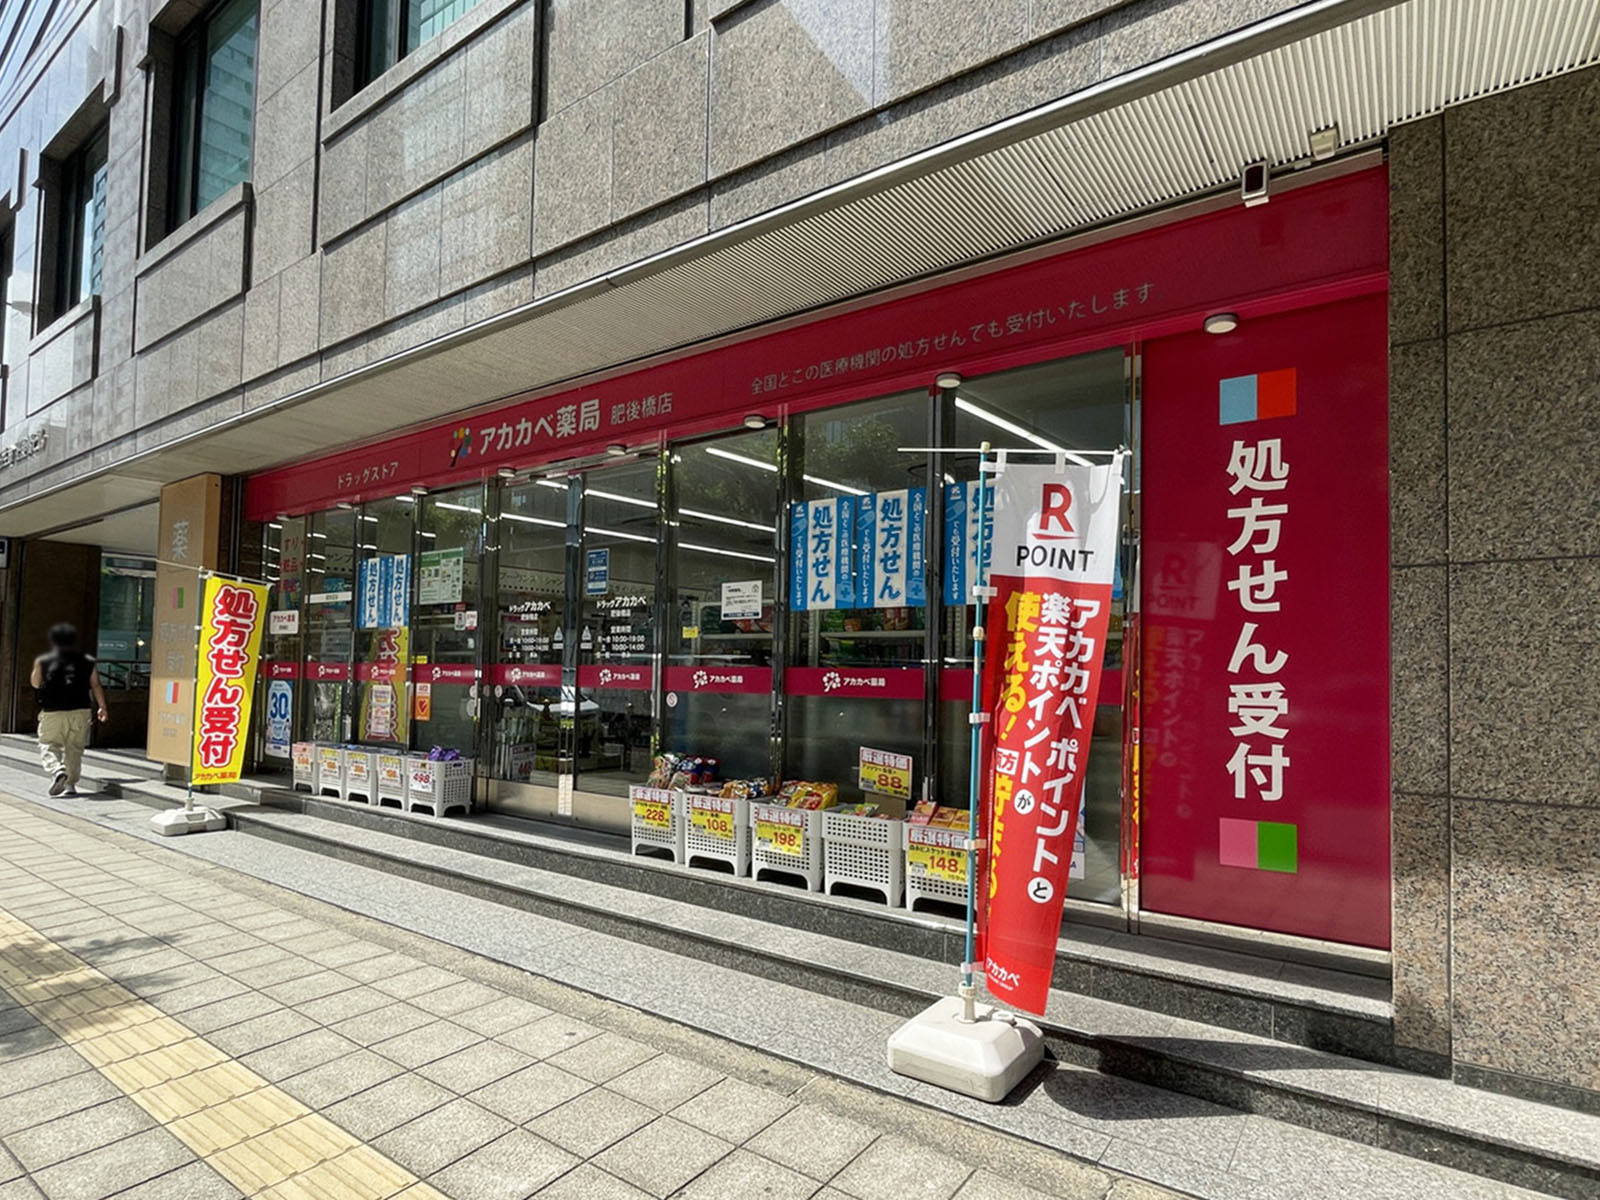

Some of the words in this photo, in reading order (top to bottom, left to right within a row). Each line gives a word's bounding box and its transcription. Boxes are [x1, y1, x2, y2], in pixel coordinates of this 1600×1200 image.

[480, 399, 601, 455] アカカベ薬局
[611, 392, 673, 425] 肥後橋店
[337, 461, 399, 490] ドラッグストア
[1039, 483, 1074, 532] R
[812, 506, 833, 603] 処方せん
[879, 498, 903, 600] 処方せん
[1017, 545, 1094, 572] POINT
[1226, 437, 1291, 802] 処方せん受付
[199, 585, 258, 767] 処方せん受付
[709, 674, 744, 684] アカカベ薬局
[842, 676, 886, 687] アカカベ薬局
[270, 692, 289, 720] 30
[1016, 592, 1071, 813] 楽天ポイントが
[877, 773, 903, 789] 88
[646, 808, 665, 822] 228
[706, 818, 728, 833] 108
[773, 831, 797, 847] 198
[929, 855, 959, 873] 148
